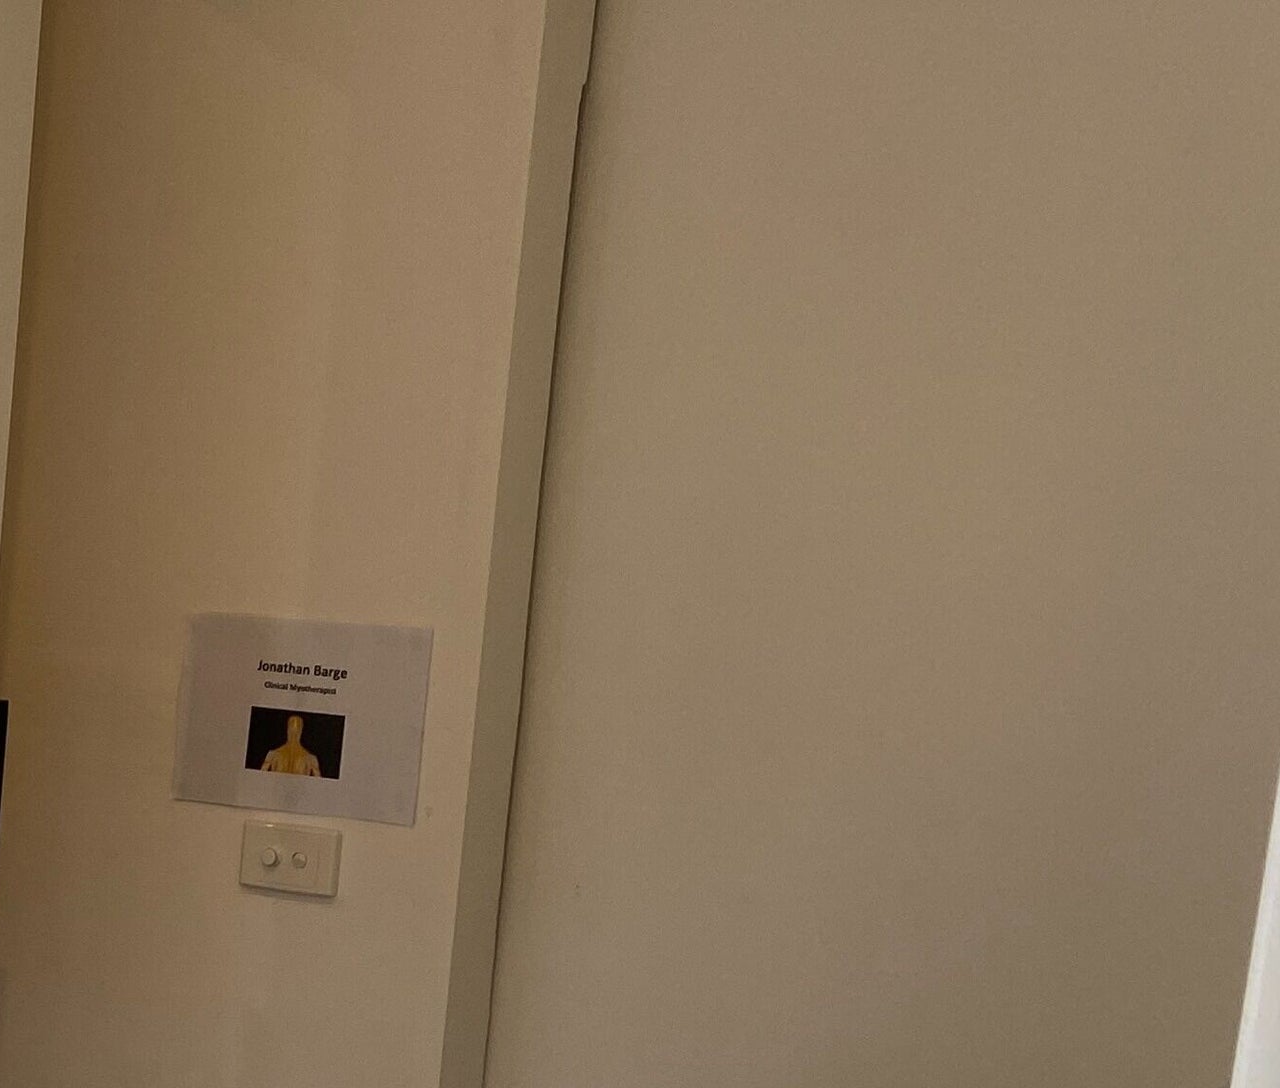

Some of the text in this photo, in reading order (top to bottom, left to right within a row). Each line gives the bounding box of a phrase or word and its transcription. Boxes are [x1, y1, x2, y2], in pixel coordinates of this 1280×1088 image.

[257, 660, 348, 681] Jonathan Barge
[264, 681, 337, 695] Clinical Myotherapist
